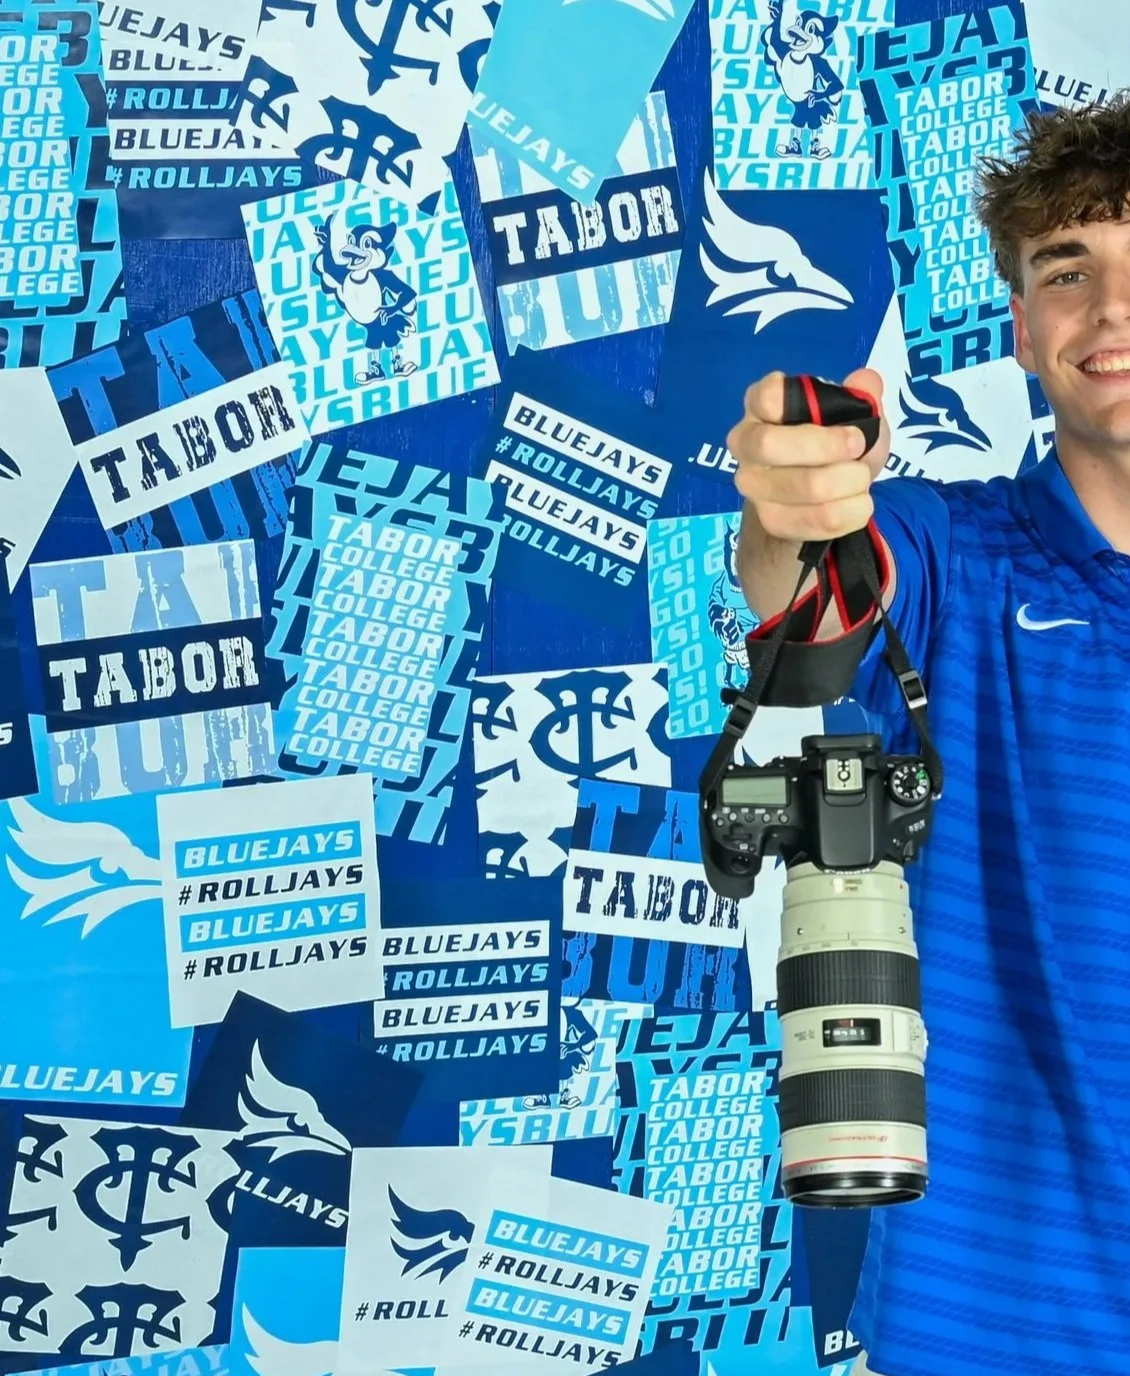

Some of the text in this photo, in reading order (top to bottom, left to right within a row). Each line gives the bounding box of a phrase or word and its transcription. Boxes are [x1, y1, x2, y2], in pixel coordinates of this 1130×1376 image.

[106, 88, 239, 110] #ROLLJ
[895, 71, 1005, 117] TABOR
[901, 95, 1007, 136] COLLEGE
[903, 114, 1012, 162] TABOR
[494, 184, 679, 266] TABOR
[90, 384, 296, 504] TABOR
[513, 405, 663, 485] BLUEJAYS
[496, 436, 659, 519] #ROLLJAYS
[328, 514, 460, 569] TABOR
[323, 542, 455, 588] COLLEGE
[318, 563, 451, 614] TABOR
[313, 589, 446, 633] COLLEGE
[305, 638, 439, 679] COLLEGE
[309, 611, 443, 662] TABOR
[48, 635, 260, 713] TABOR
[301, 658, 434, 707] TABOR
[297, 686, 430, 728] COLLEGE
[293, 706, 426, 755] TABOR
[289, 733, 421, 776] COLLEGE
[183, 828, 355, 868] BLUEJAYS
[178, 864, 364, 906] #ROLLJAYS
[572, 866, 740, 930] TABOR
[188, 901, 359, 944] BLUEJAYS
[382, 930, 542, 956] BLUEJAYS
[184, 936, 368, 980] #ROLLJAYS
[382, 1000, 540, 1028] BLUEJAYS
[0, 1064, 178, 1096] LUEJAYS
[650, 1070, 766, 1102] TABOR
[649, 1095, 763, 1122] COLLEGE
[649, 1114, 764, 1146] TABOR
[648, 1138, 763, 1166] COLLEGE
[648, 1158, 763, 1190] TABOR
[492, 1220, 643, 1270] BLUEJAYS
[479, 1251, 639, 1303] #ROLLJAYS
[355, 1299, 449, 1322] #ROLL
[473, 1288, 625, 1336] BLUEJAYS
[458, 1320, 622, 1366] #ROLLJAYS
